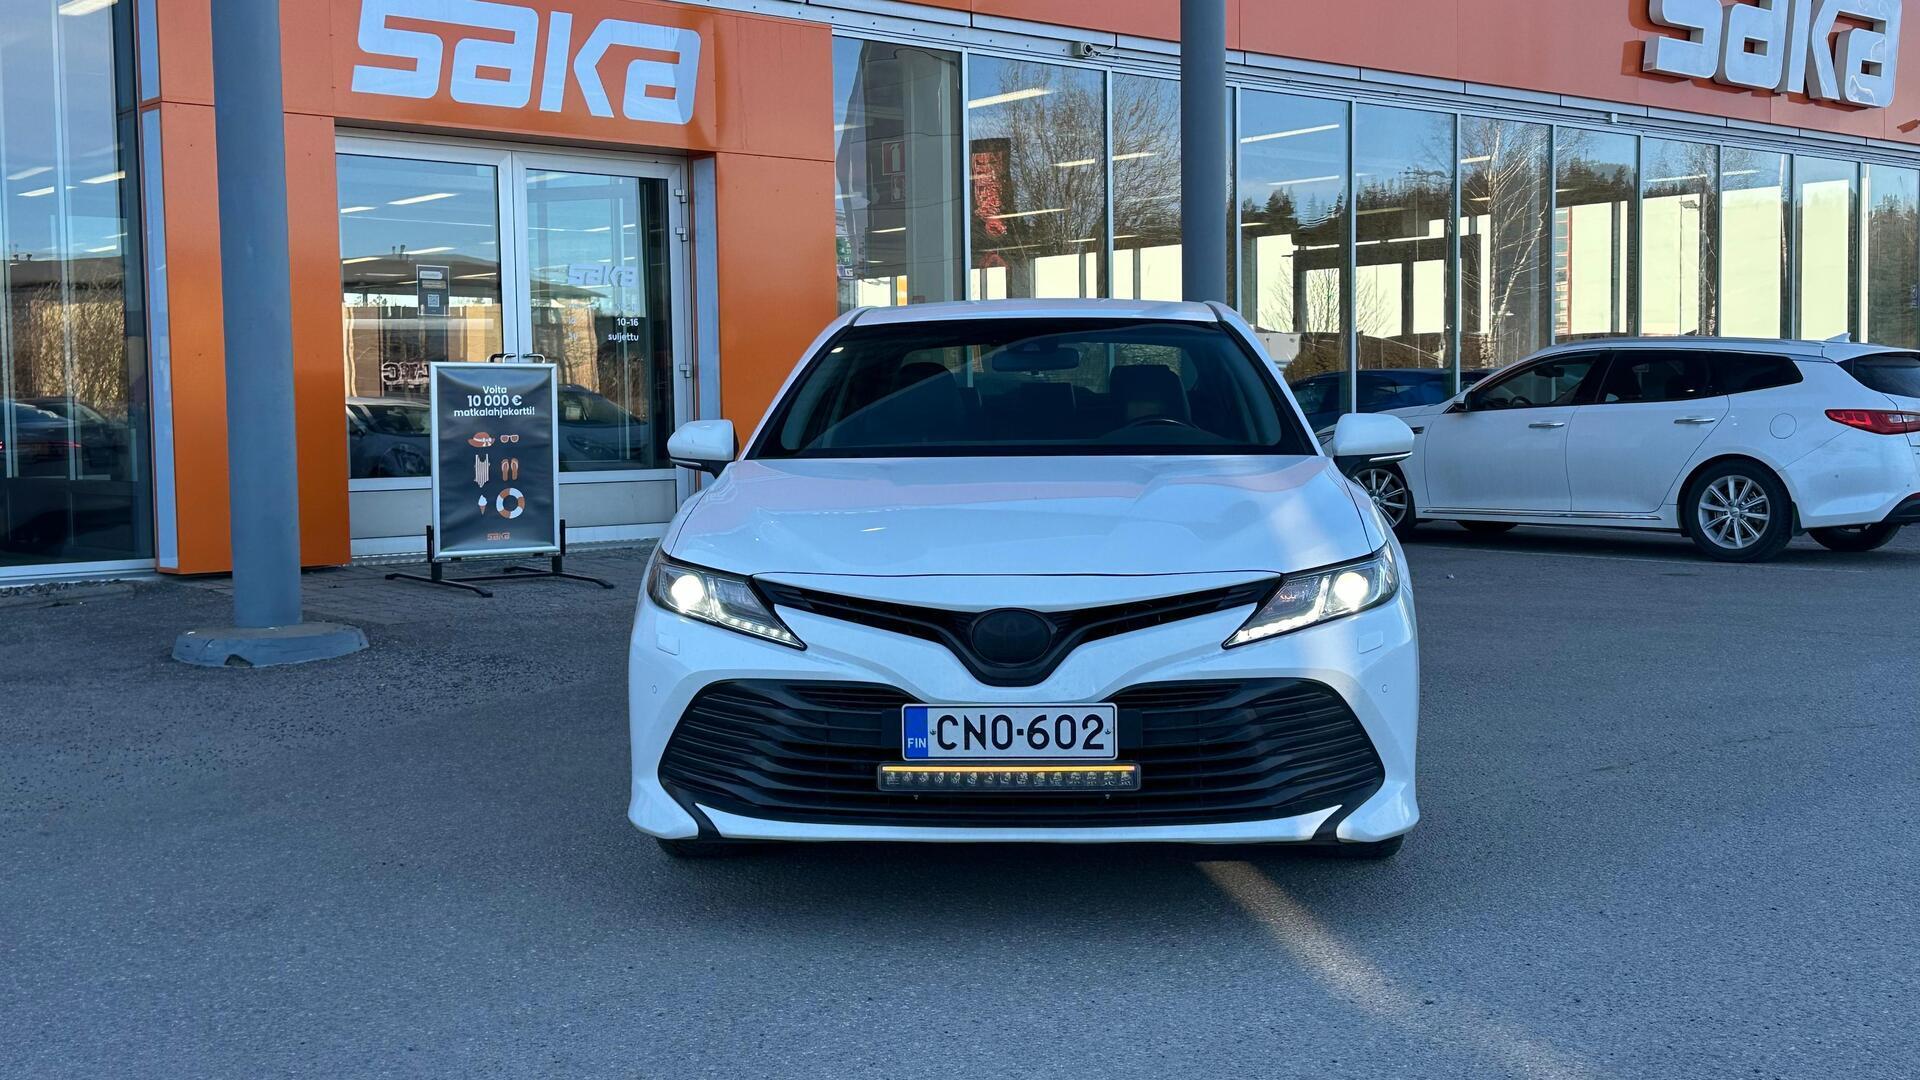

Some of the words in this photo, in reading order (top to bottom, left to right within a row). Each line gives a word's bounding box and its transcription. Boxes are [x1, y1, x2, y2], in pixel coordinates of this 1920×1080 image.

[617, 318, 639, 327] 10-16
[608, 332, 639, 342] suljettu
[483, 385, 507, 394] Voita
[467, 395, 481, 407] 10
[484, 395, 509, 407] 000
[512, 395, 522, 406] €
[454, 406, 535, 418] matkalahjakortti!
[907, 738, 927, 749] FIN
[937, 714, 1105, 751] CNO-602
